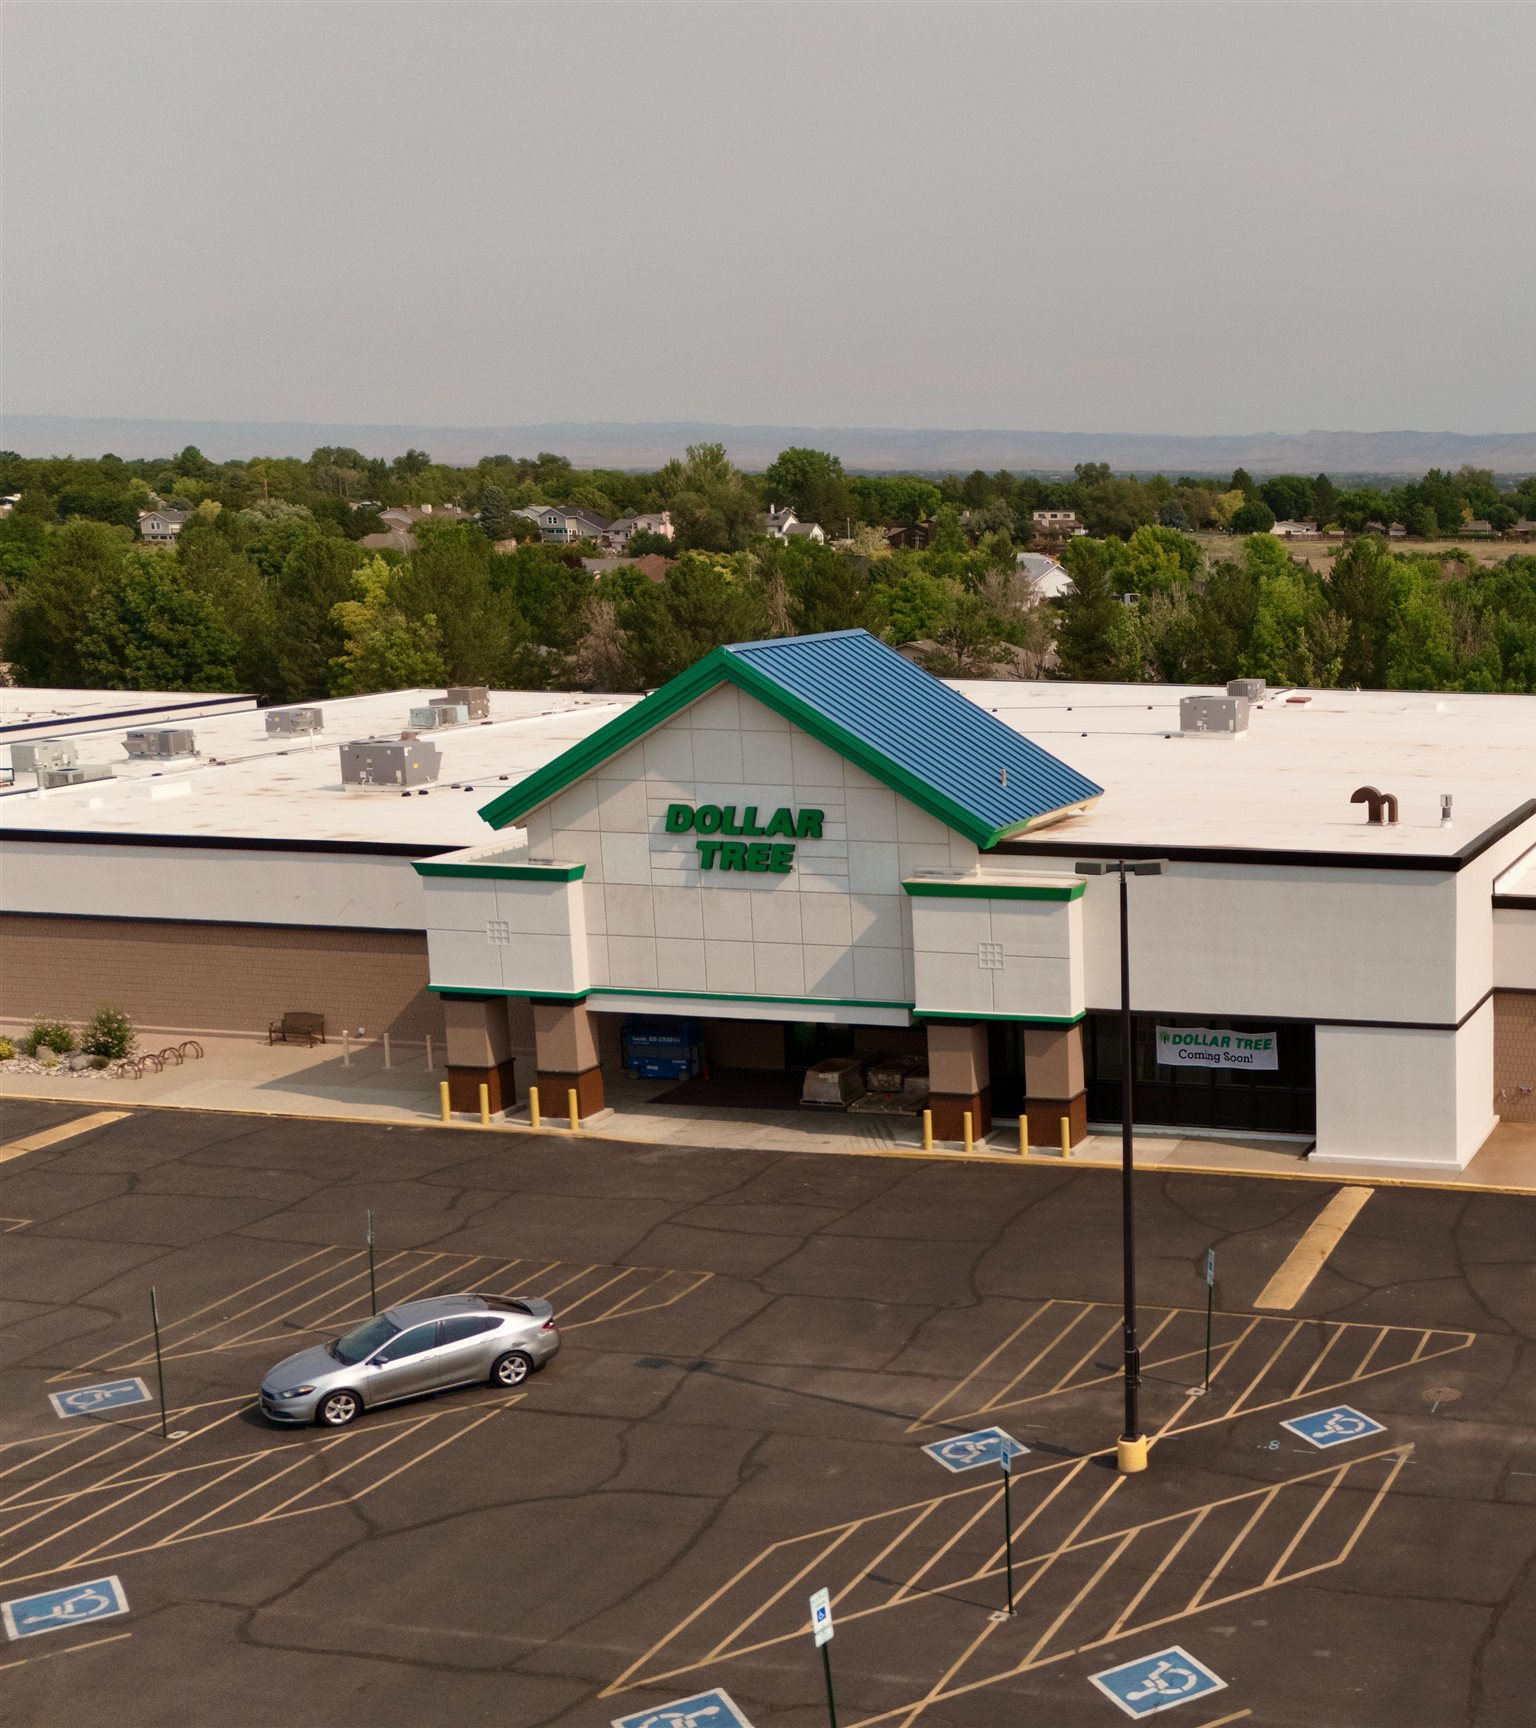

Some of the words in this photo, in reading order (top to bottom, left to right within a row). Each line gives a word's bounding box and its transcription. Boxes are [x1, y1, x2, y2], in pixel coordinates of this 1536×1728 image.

[665, 804, 824, 838] DOLLAR
[696, 841, 796, 873] TREE
[1172, 1034, 1230, 1047] DOLLAR
[1236, 1037, 1273, 1050] TREE
[1178, 1049, 1221, 1063] Coming
[1223, 1052, 1253, 1063] Soon!
